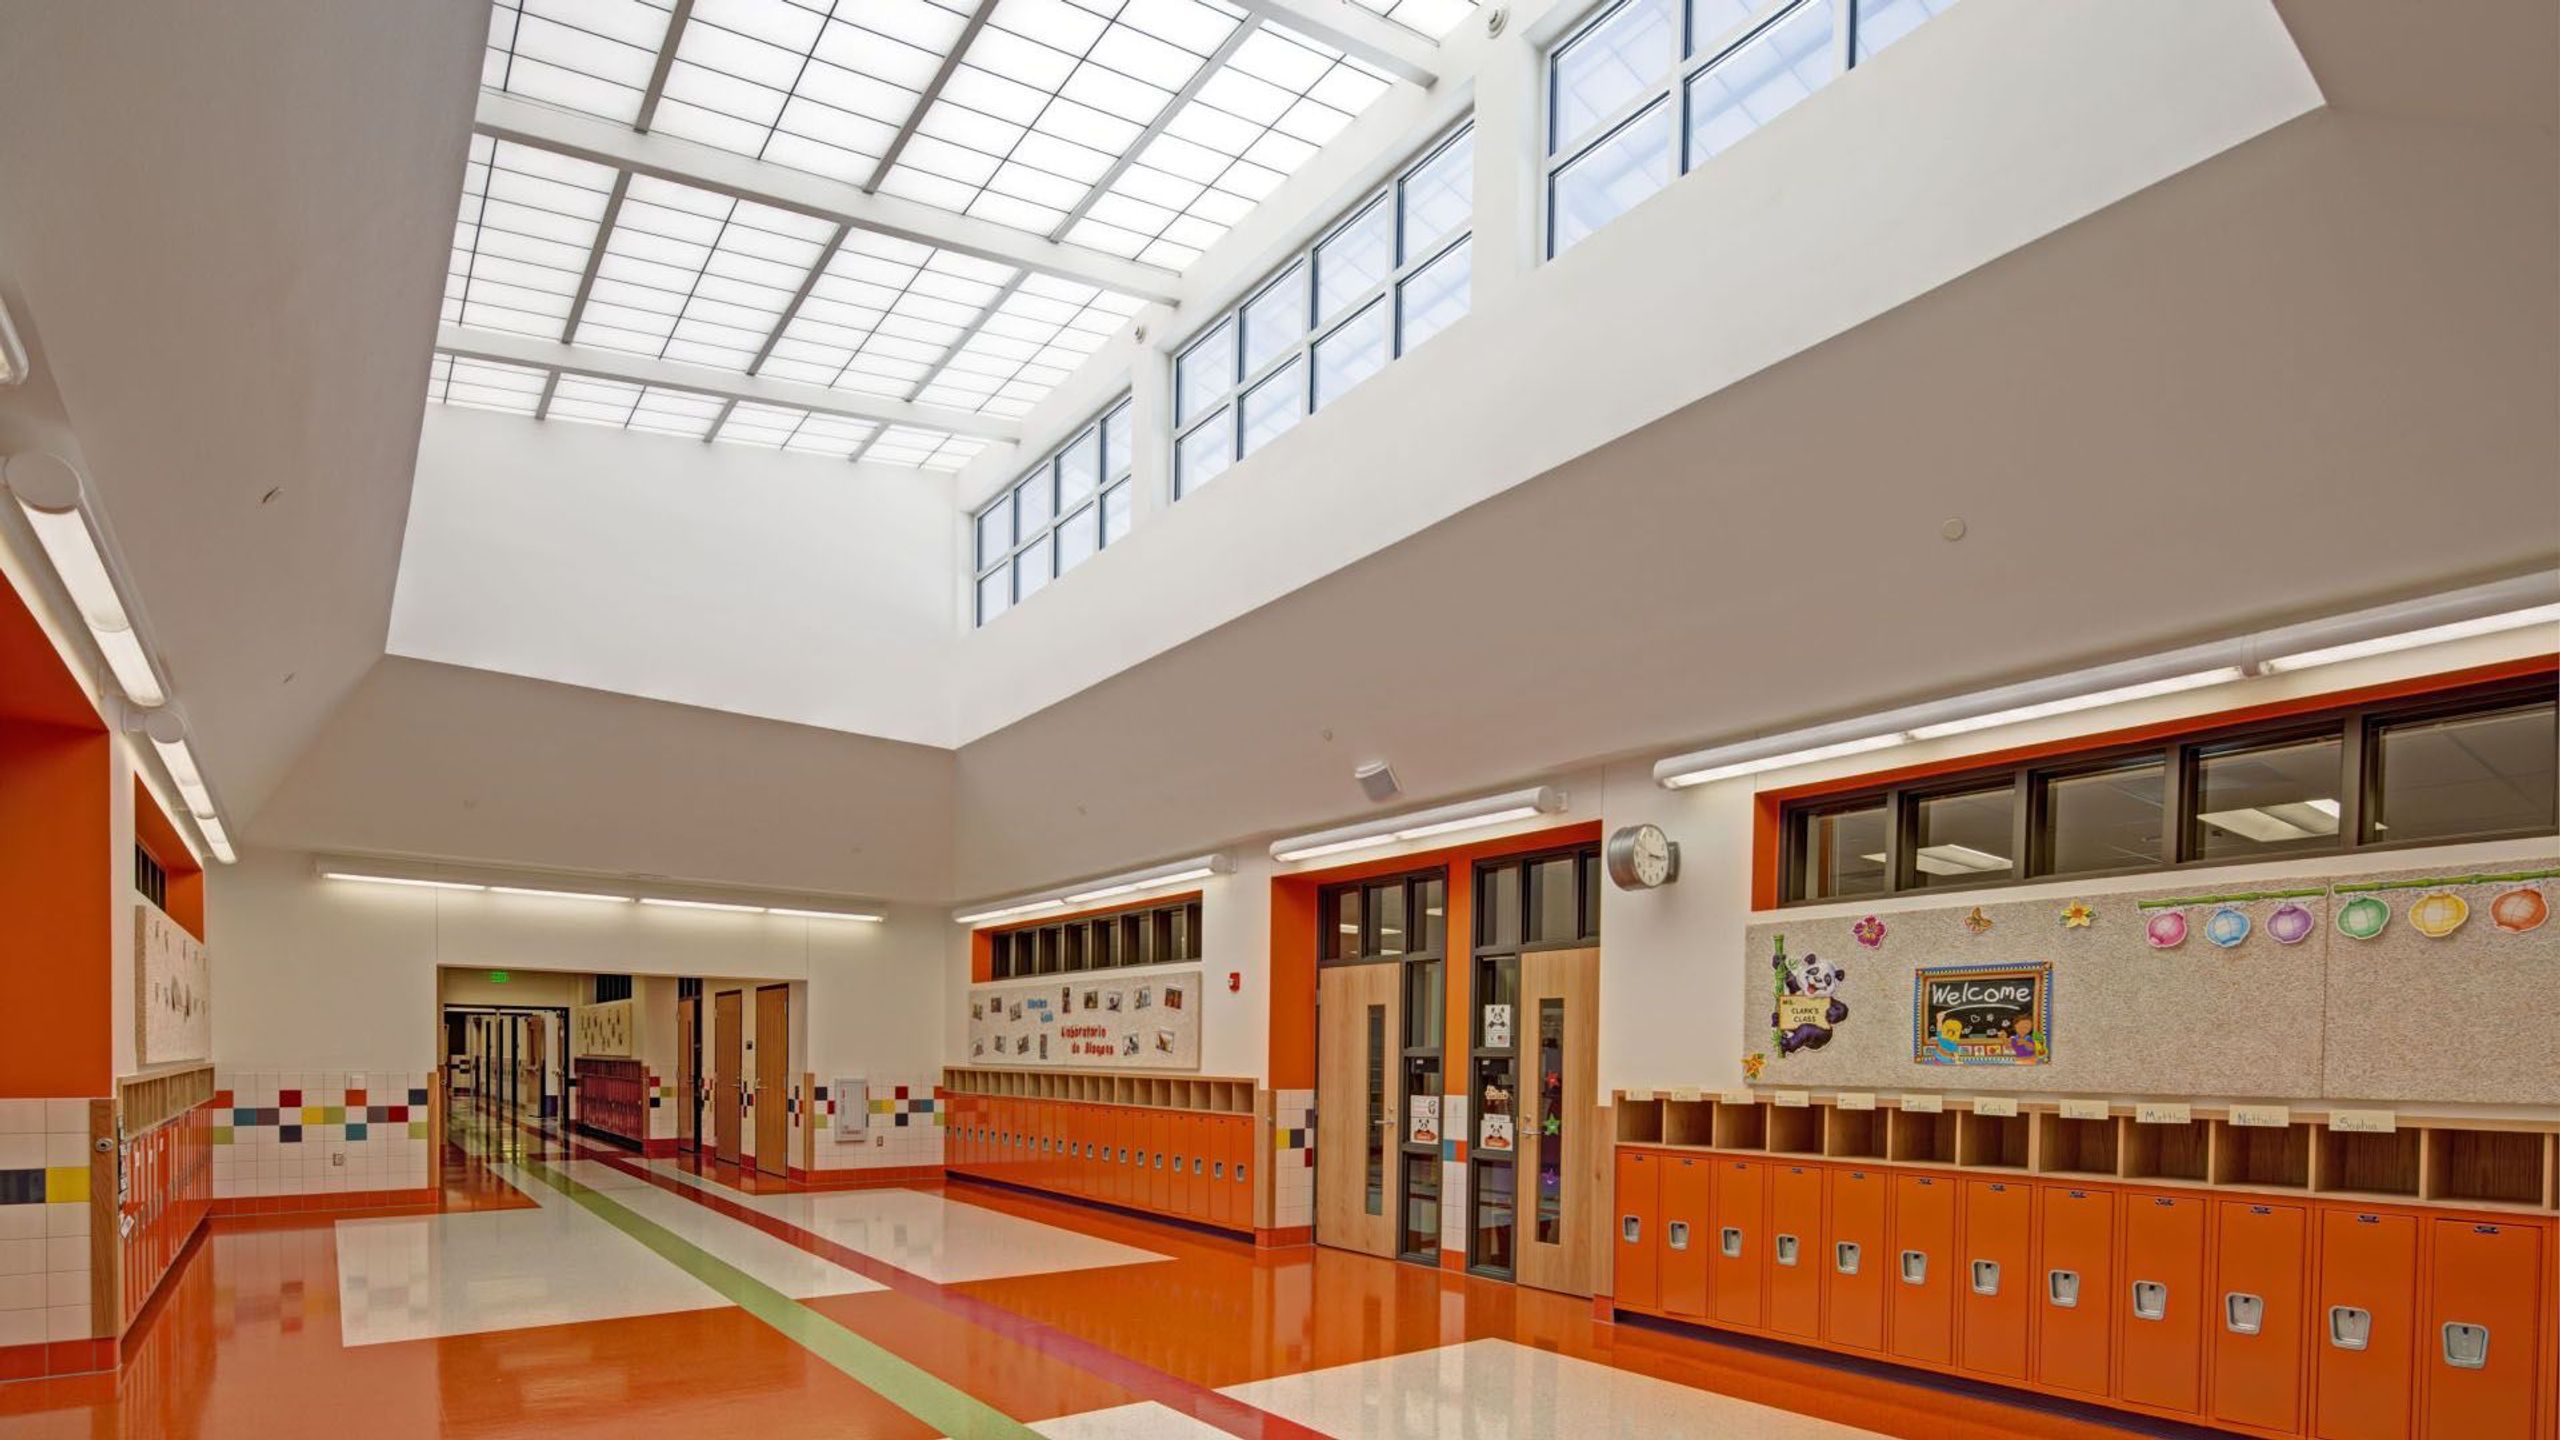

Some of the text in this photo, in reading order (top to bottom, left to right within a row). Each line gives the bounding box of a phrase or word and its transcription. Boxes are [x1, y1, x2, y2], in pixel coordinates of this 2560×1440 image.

[1931, 981, 2032, 1006] Welcome
[1791, 1007, 1819, 1015] CLARK'S
[1793, 1015, 1816, 1023] CLASS
[1061, 1025, 1107, 1039] Laboratorio
